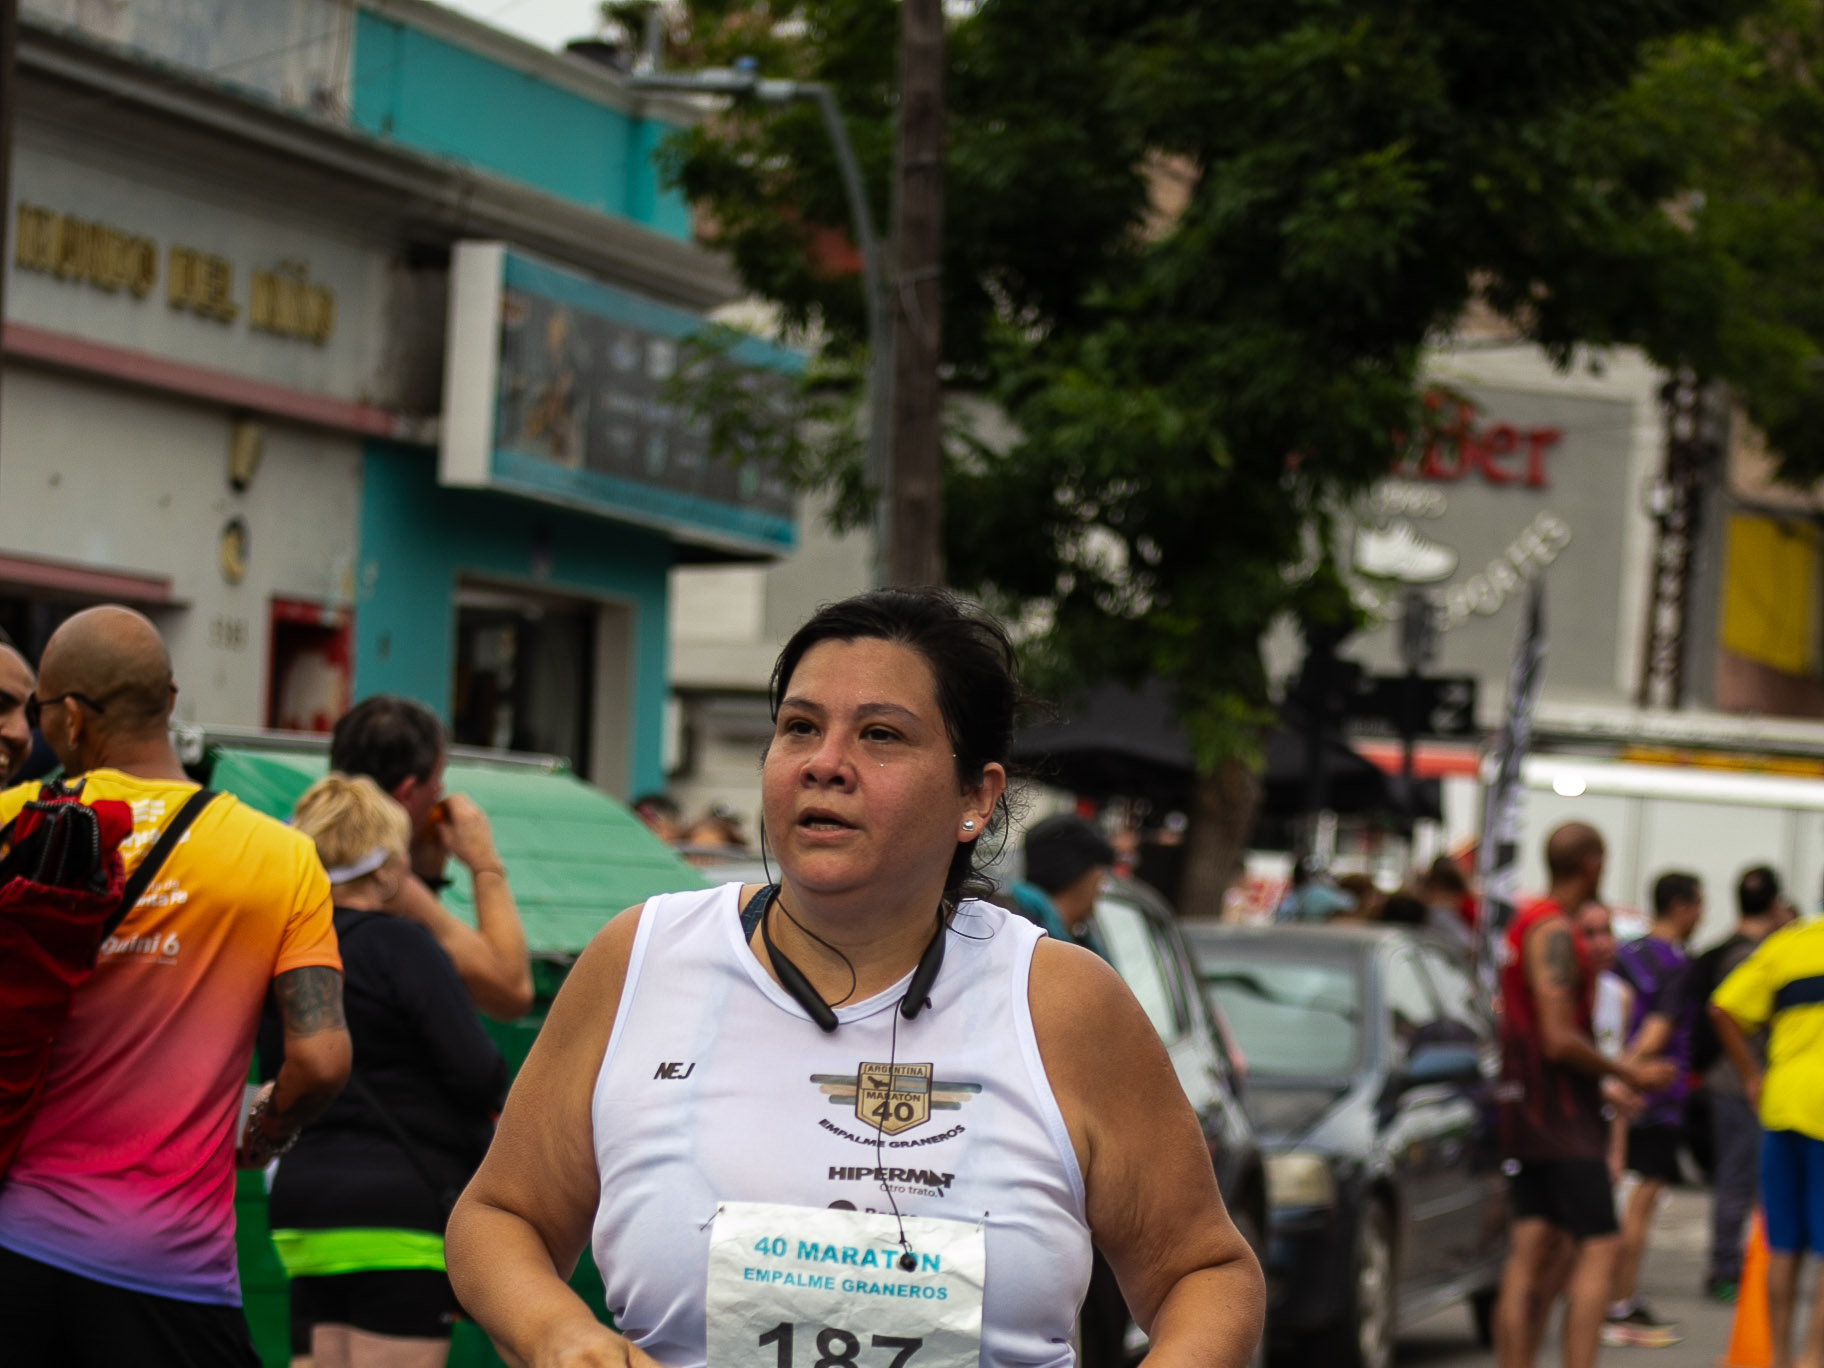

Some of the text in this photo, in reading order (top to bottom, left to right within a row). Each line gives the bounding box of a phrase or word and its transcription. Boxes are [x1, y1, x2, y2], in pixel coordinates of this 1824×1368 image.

[162, 931, 180, 957] 6
[653, 1061, 696, 1080] NEJ
[867, 1065, 924, 1076] ARGNTINA
[872, 1101, 915, 1122] 40
[818, 1118, 966, 1149] EMPALME GRANEROS
[879, 1183, 906, 1193] Otro
[754, 1237, 941, 1273] 40 MARATN
[743, 1267, 948, 1300] EMPALME GRANEROS
